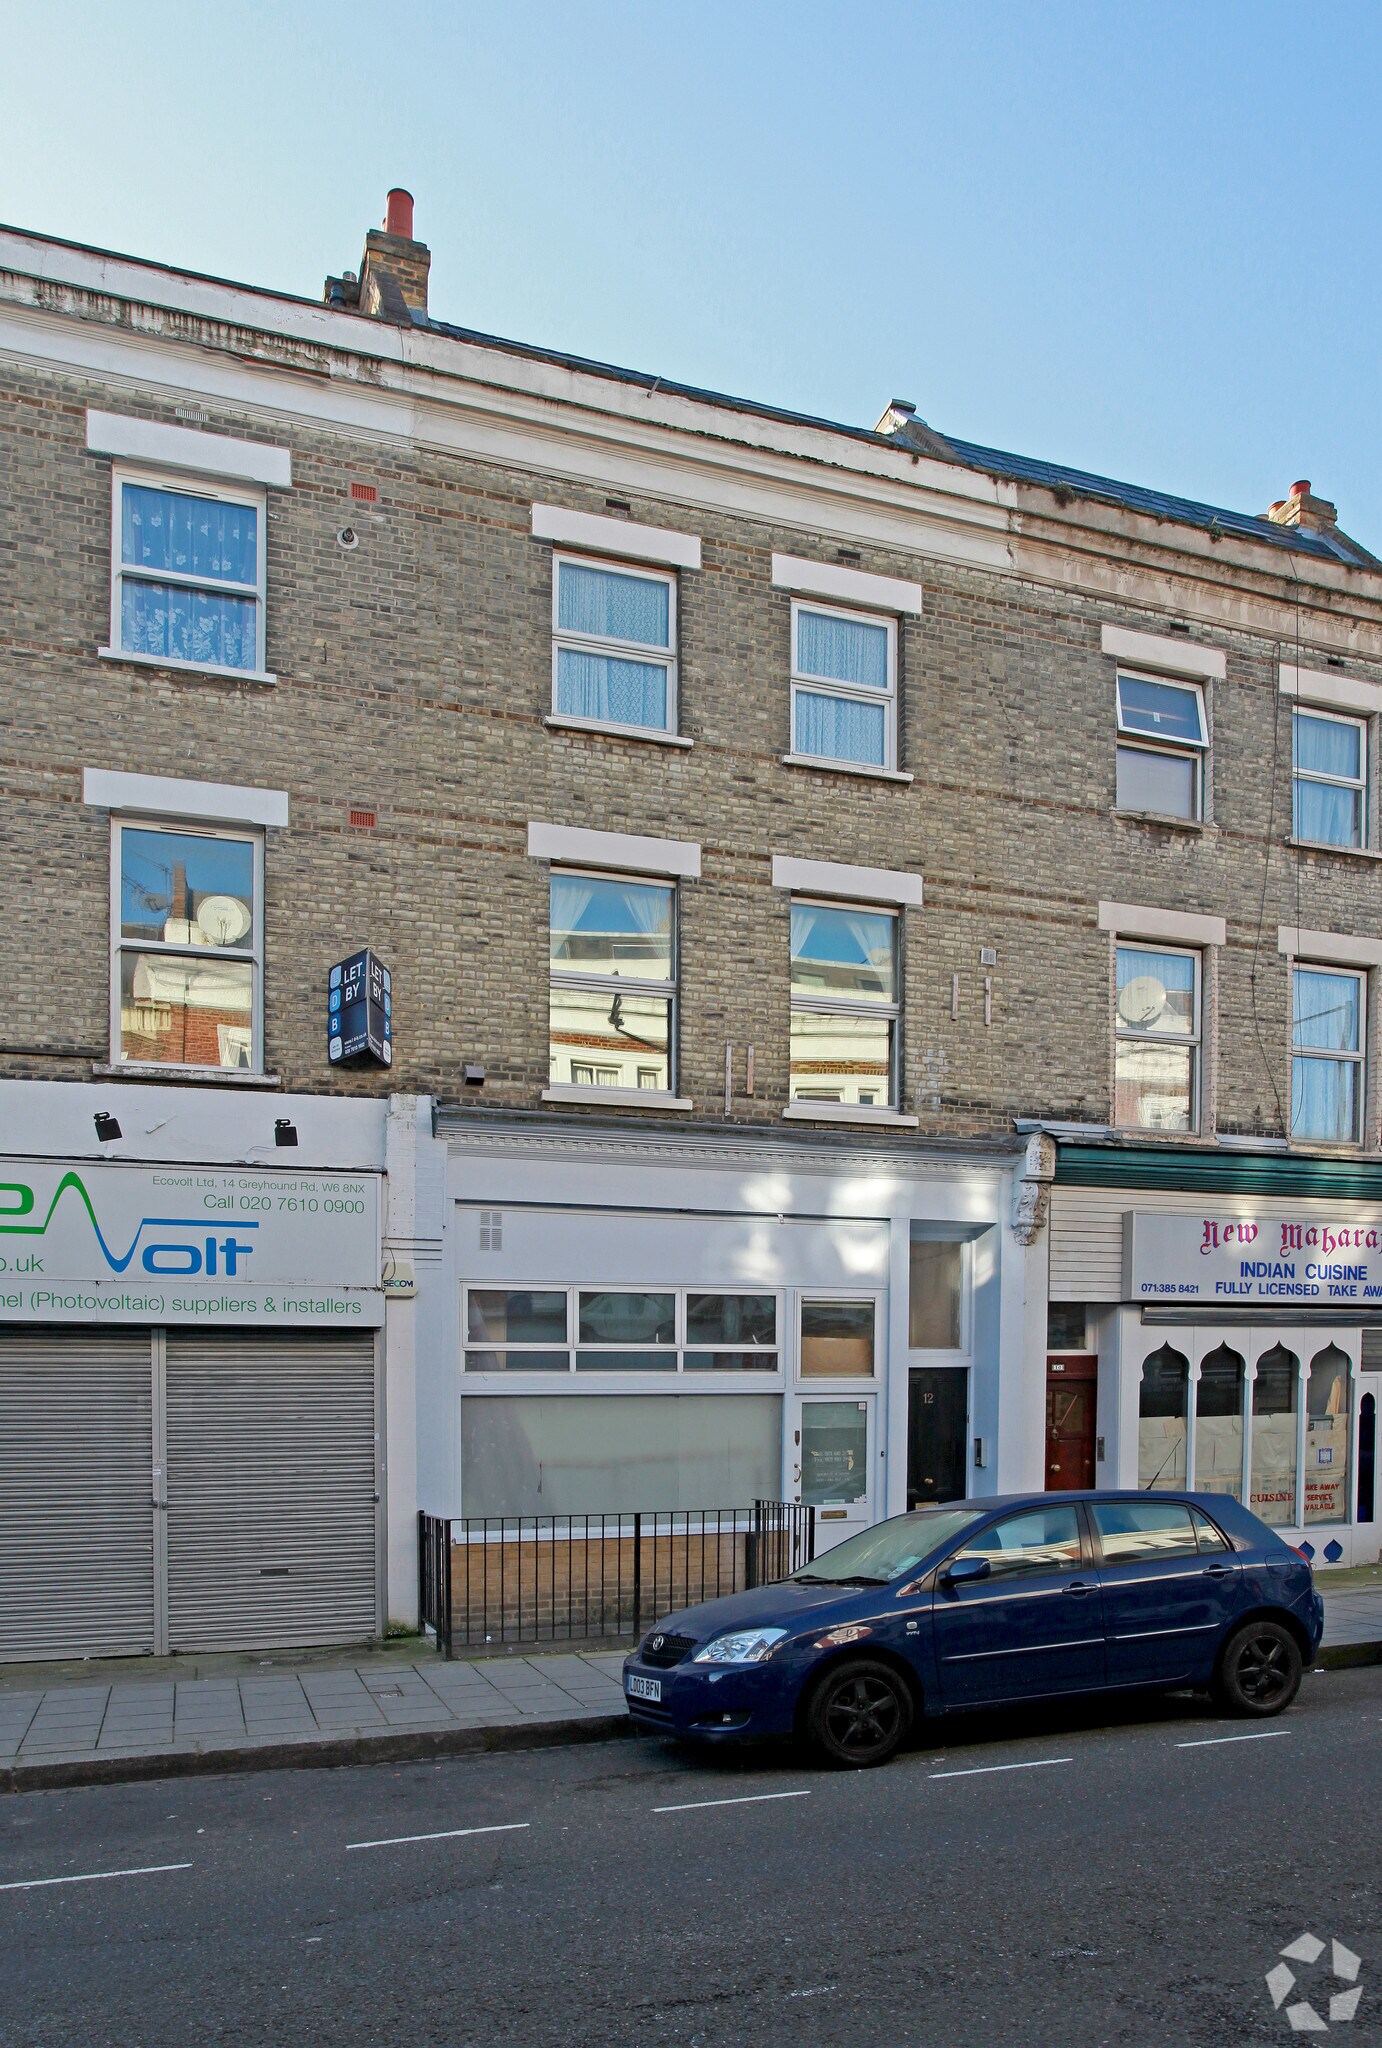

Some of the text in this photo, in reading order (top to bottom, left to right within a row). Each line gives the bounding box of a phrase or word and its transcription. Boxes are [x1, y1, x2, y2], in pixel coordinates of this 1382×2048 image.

[344, 962, 363, 984] LET
[371, 962, 382, 983] LET
[346, 982, 360, 1001] BY
[373, 982, 382, 1001] BY
[152, 1175, 365, 1194] Ecovolt Ltd, 14 Greyhound Rd, W6 8NX
[203, 1194, 365, 1214] Call 020 7610 0900
[1200, 1220, 1382, 1257] New Mahara
[1240, 1262, 1368, 1281] INDIAN CUISINE
[383, 1279, 414, 1288] SECOM
[1178, 1284, 1199, 1294] 8421
[1216, 1282, 1252, 1295] FULLY
[1259, 1283, 1319, 1296] LICENSED
[1327, 1285, 1357, 1297] TAKE
[30, 1291, 166, 1313] (Photovoltaic)
[172, 1296, 257, 1316] suppliers
[263, 1296, 278, 1313] &
[282, 1296, 362, 1315] installers
[922, 1392, 934, 1404] 12
[1320, 1483, 1339, 1491] AWAY
[1250, 1492, 1293, 1503] CUISINE
[1307, 1493, 1333, 1501] SERVICE
[646, 1681, 659, 1698] BFN
